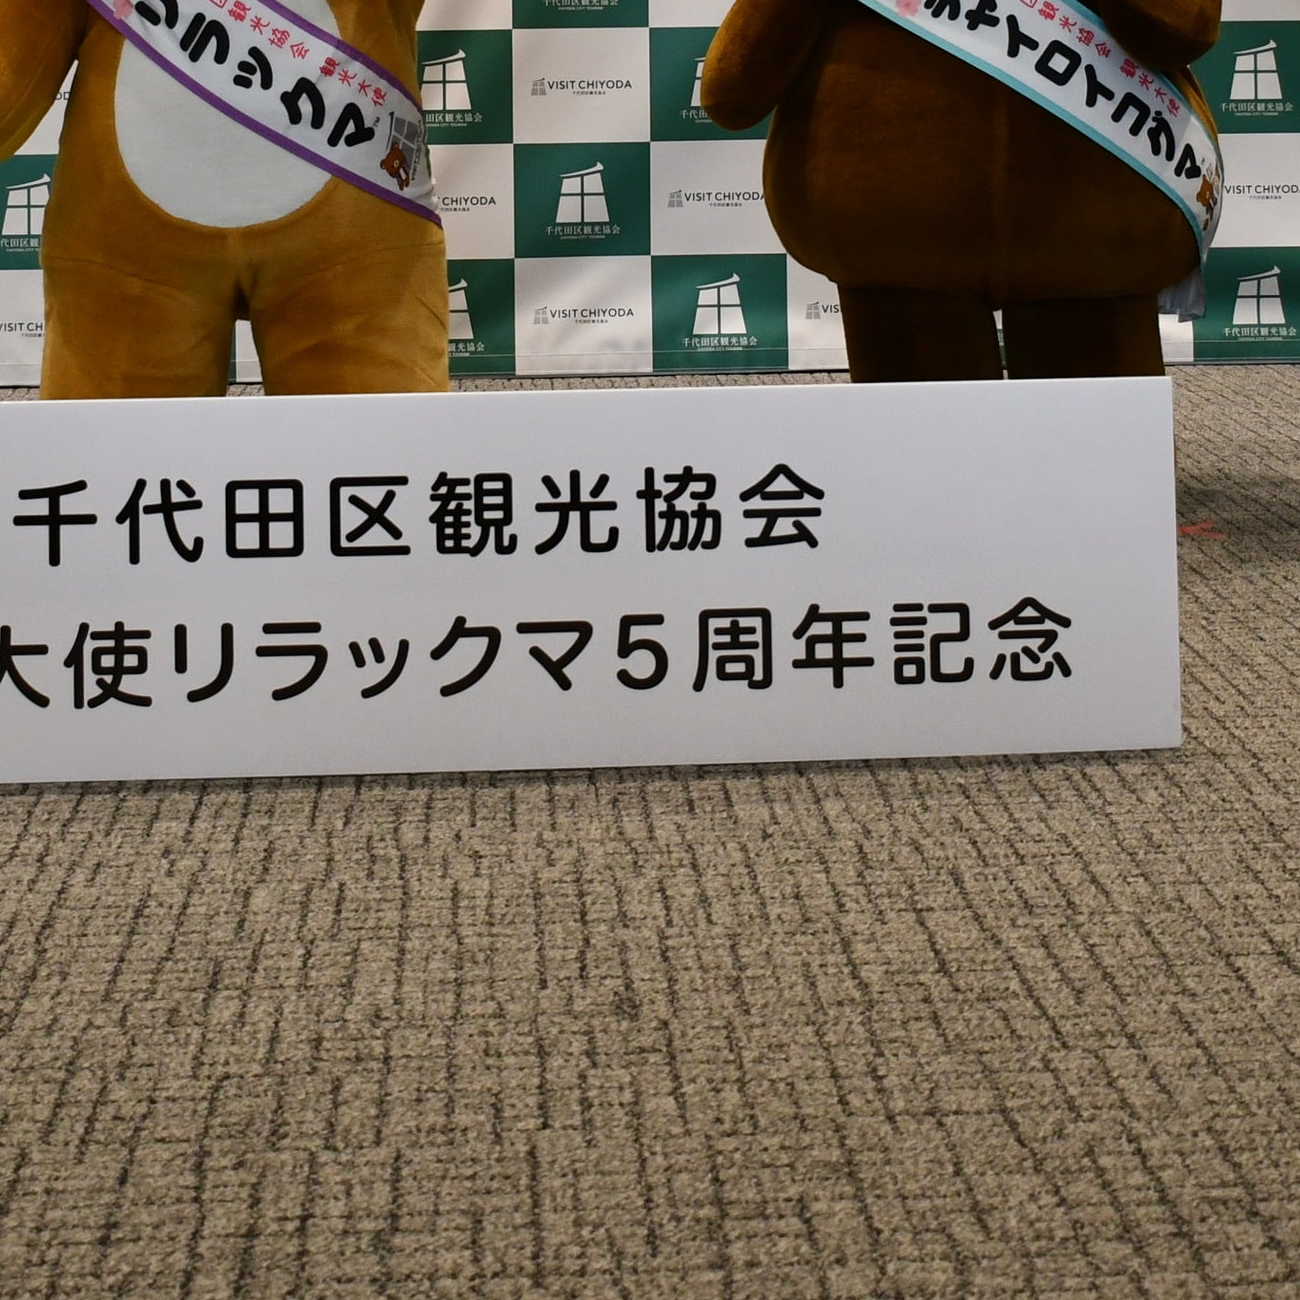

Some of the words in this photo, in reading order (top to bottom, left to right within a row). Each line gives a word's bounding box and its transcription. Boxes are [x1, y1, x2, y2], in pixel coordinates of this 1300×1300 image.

[319, 56, 387, 108] 観光大使
[548, 80, 576, 91] VISIT
[578, 79, 632, 90] CHIYODA
[426, 113, 483, 123] 田区観光協会
[1224, 184, 1253, 195] VISIT
[443, 196, 496, 207] CHIYODA
[684, 192, 712, 202] VISIT
[550, 308, 578, 319] VISIT
[580, 307, 634, 318] CHIYODA
[822, 305, 840, 314] VIS
[12, 463, 826, 567] 千代田区観光協会
